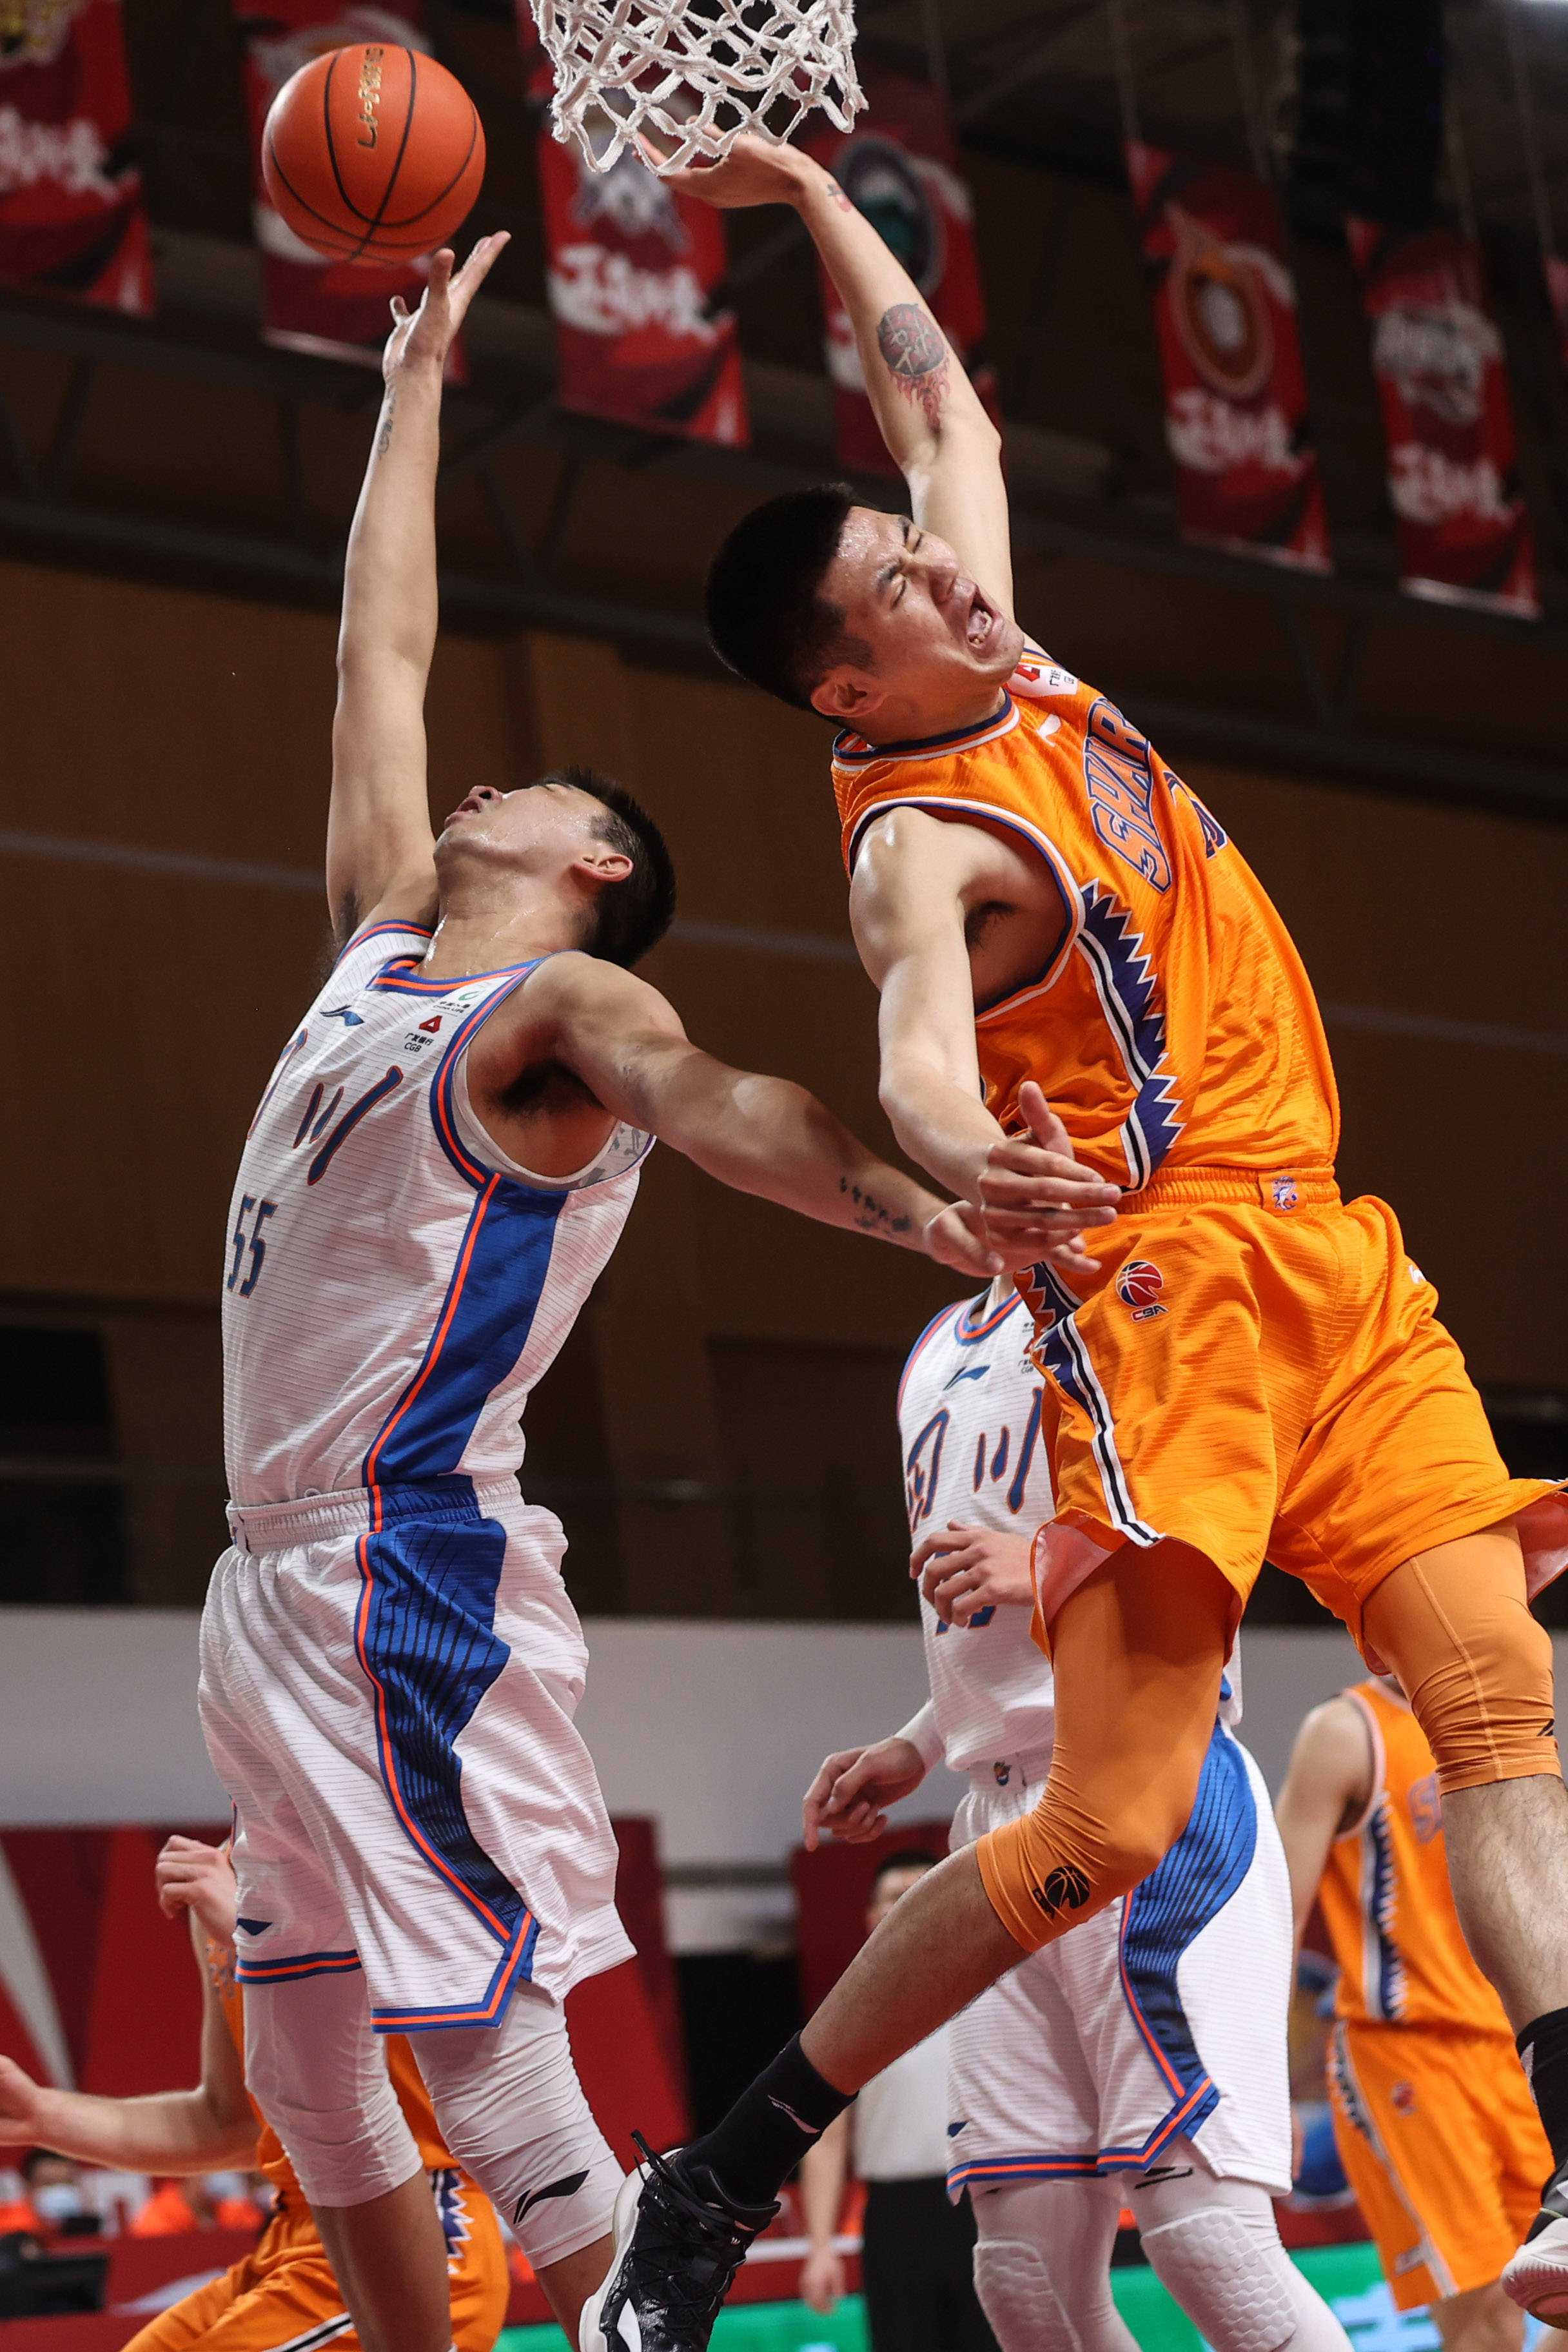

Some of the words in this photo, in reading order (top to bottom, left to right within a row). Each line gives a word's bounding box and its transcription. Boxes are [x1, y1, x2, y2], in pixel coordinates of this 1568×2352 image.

[404, 1042, 422, 1053] CGB
[226, 1193, 279, 1298] 55
[1131, 1304, 1168, 1322] CBA
